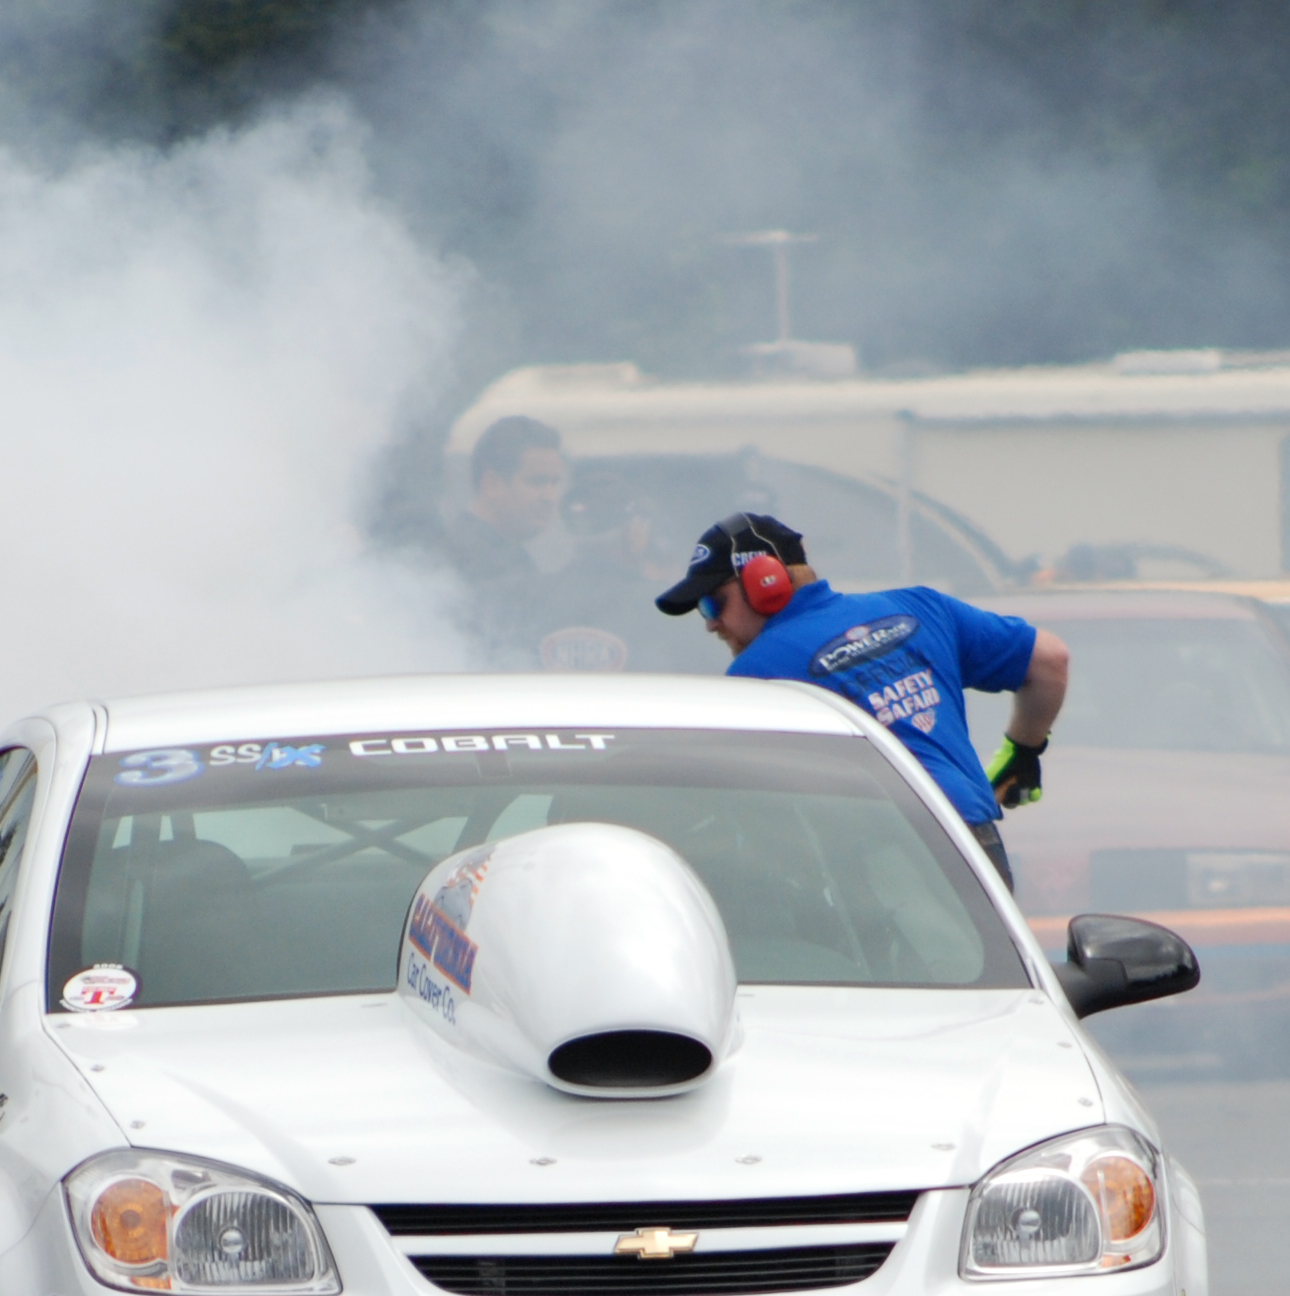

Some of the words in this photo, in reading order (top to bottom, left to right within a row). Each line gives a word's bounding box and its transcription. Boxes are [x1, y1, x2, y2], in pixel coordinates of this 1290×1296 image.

[731, 550, 768, 567] CRE
[868, 668, 933, 710] SAFETY
[875, 687, 941, 727] SAFARI
[113, 748, 205, 787] 3
[348, 733, 616, 757] COBALT
[406, 952, 420, 990] Car
[418, 963, 443, 1013] Cover
